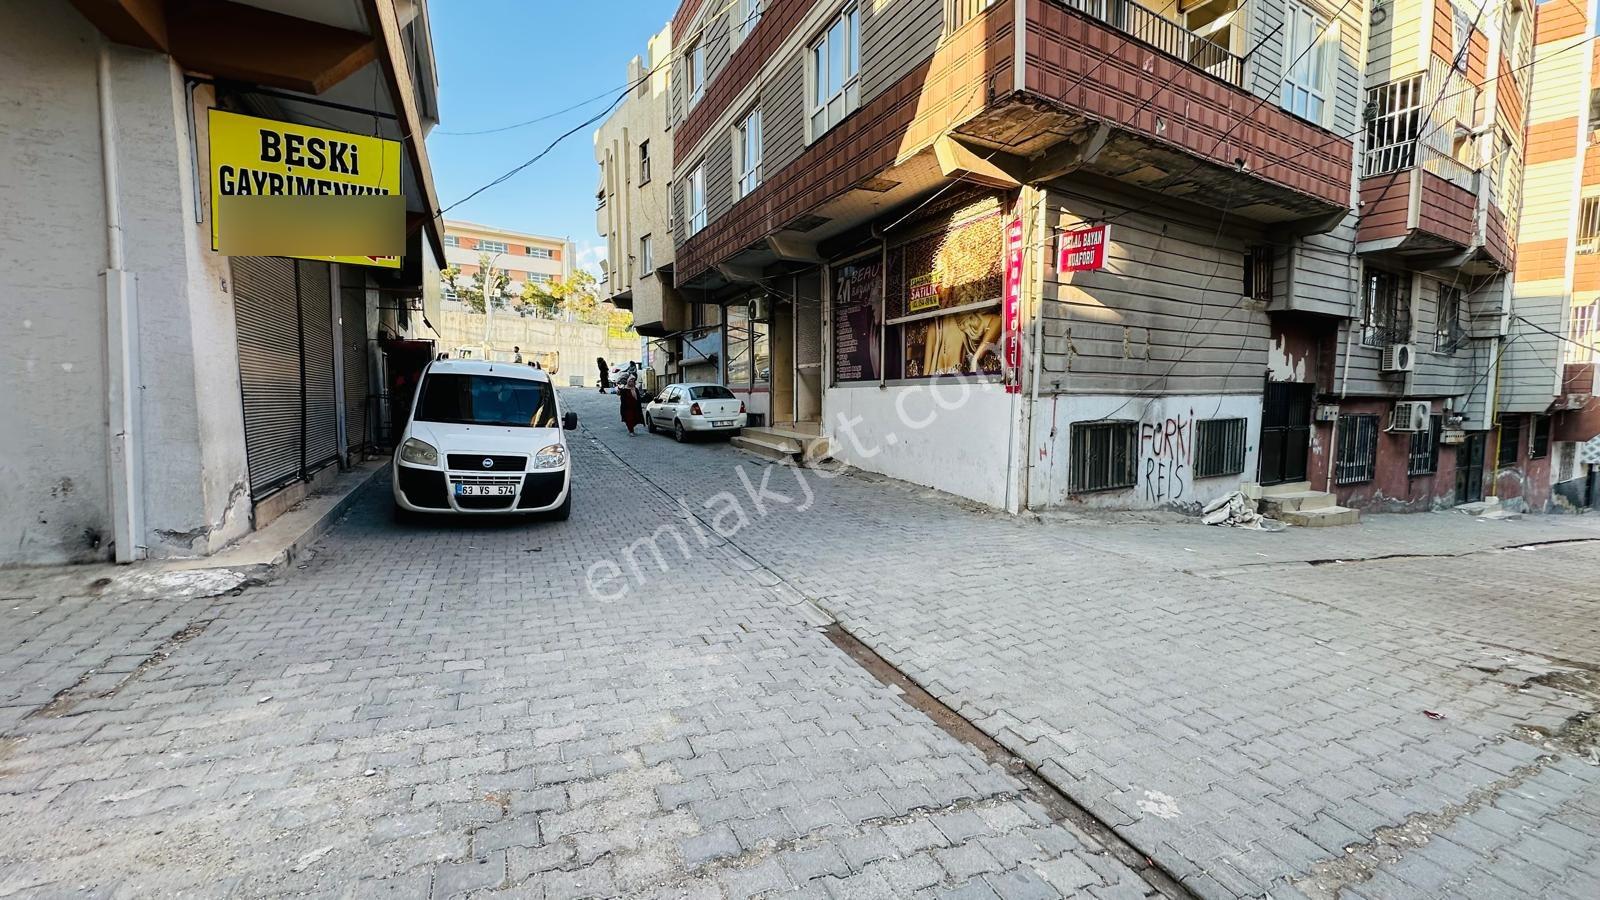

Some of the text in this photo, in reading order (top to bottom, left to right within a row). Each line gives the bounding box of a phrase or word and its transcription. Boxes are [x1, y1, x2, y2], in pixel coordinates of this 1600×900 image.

[219, 165, 389, 195] GAYRİME
[1083, 230, 1103, 247] BAYAN
[910, 283, 938, 300] SATILIK
[462, 486, 513, 495] 63 VS 574
